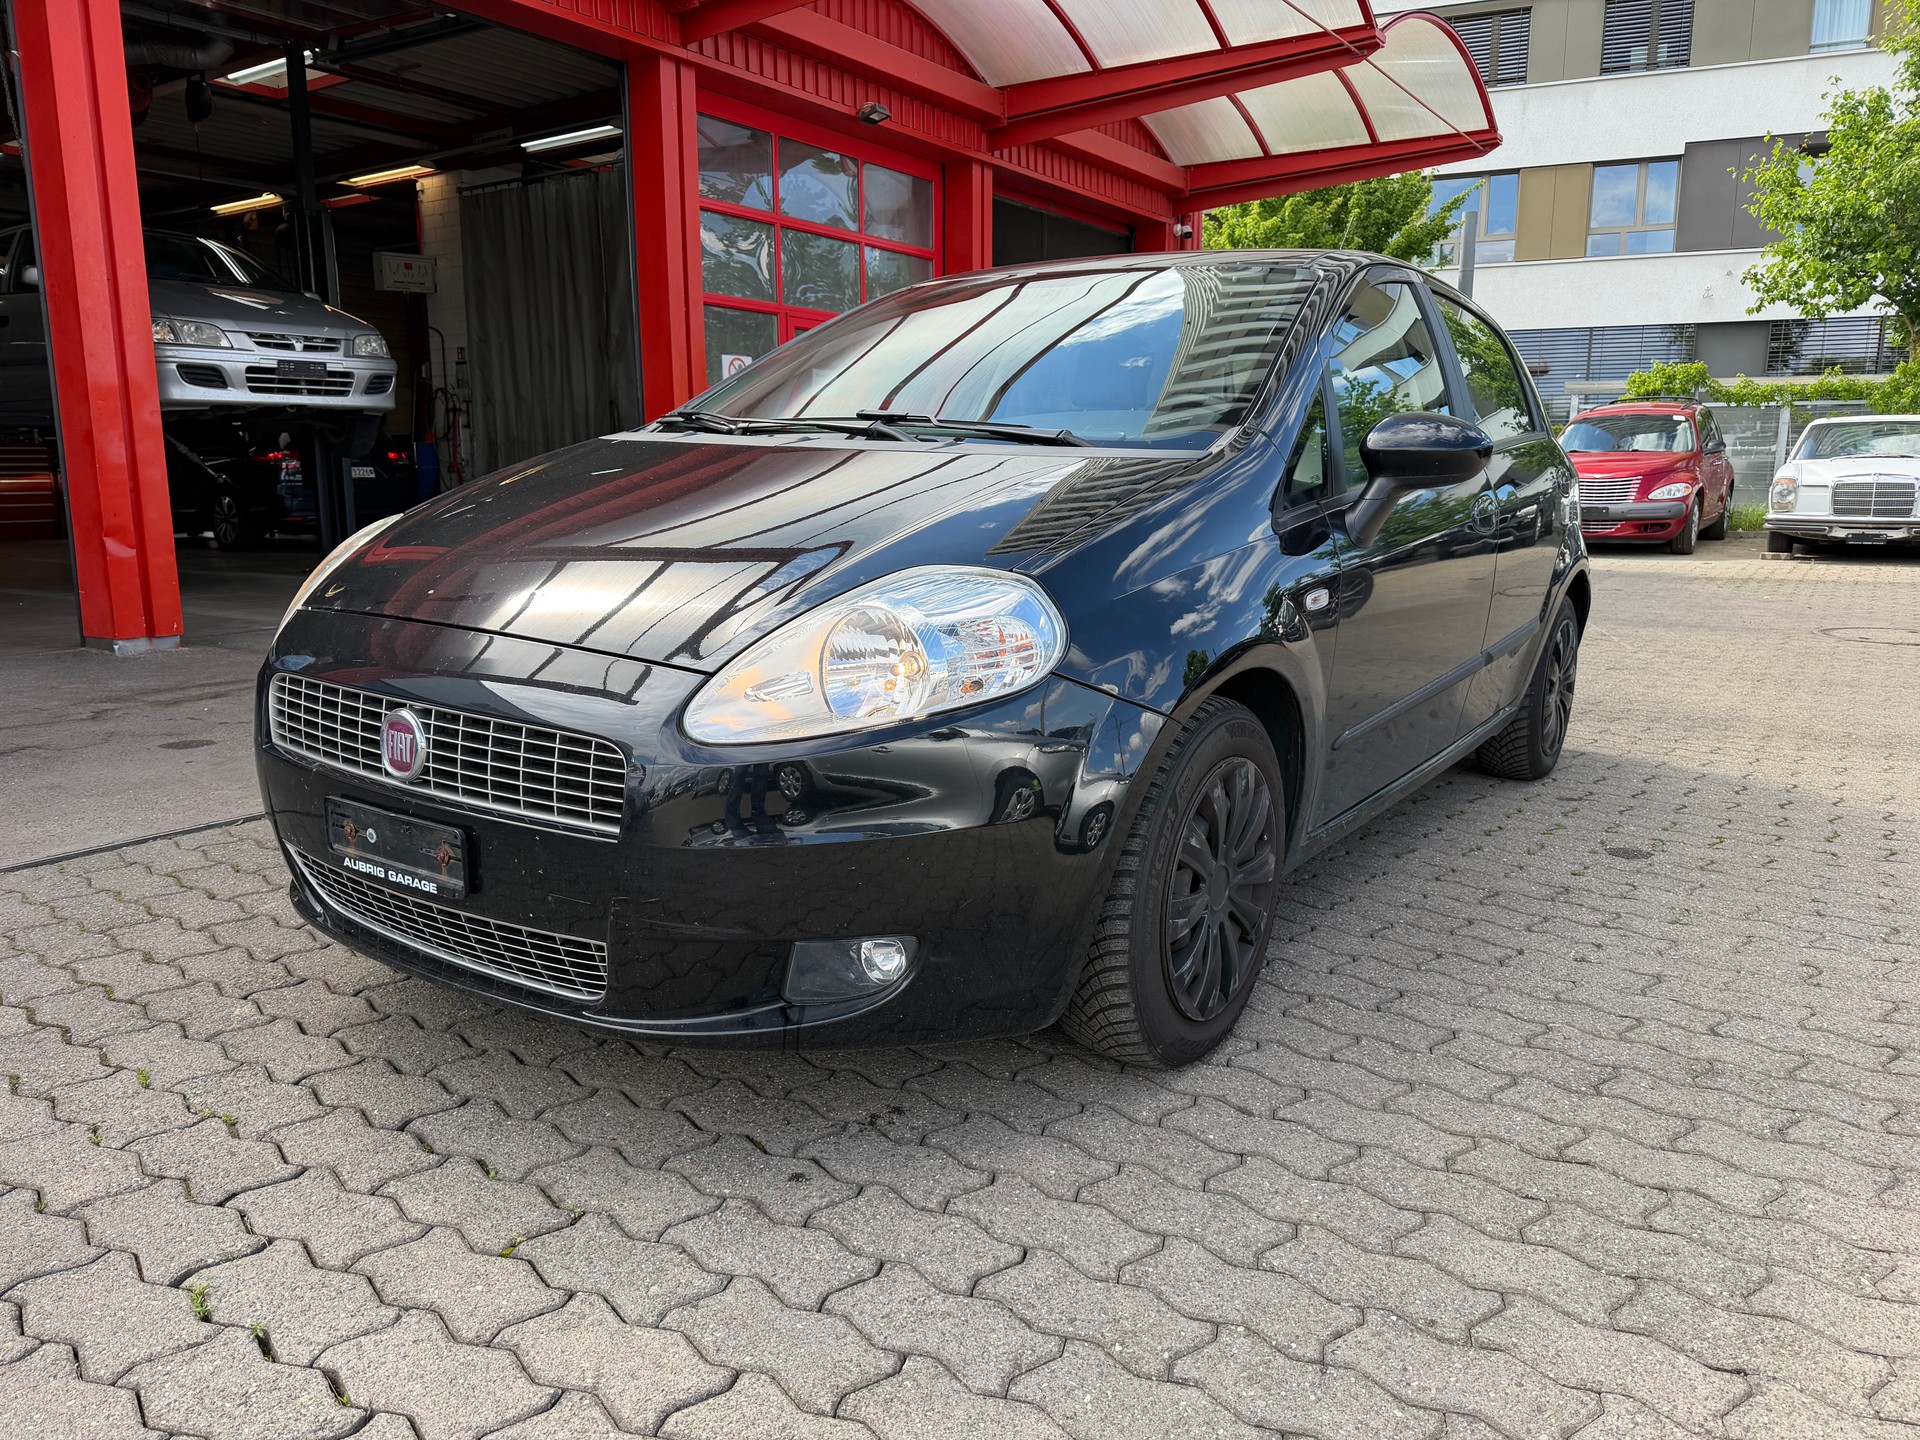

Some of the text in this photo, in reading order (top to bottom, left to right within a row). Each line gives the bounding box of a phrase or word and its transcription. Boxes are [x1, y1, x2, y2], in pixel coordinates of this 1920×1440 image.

[388, 729, 413, 763] FIAT
[343, 857, 438, 894] AUBRIG GARAGE
